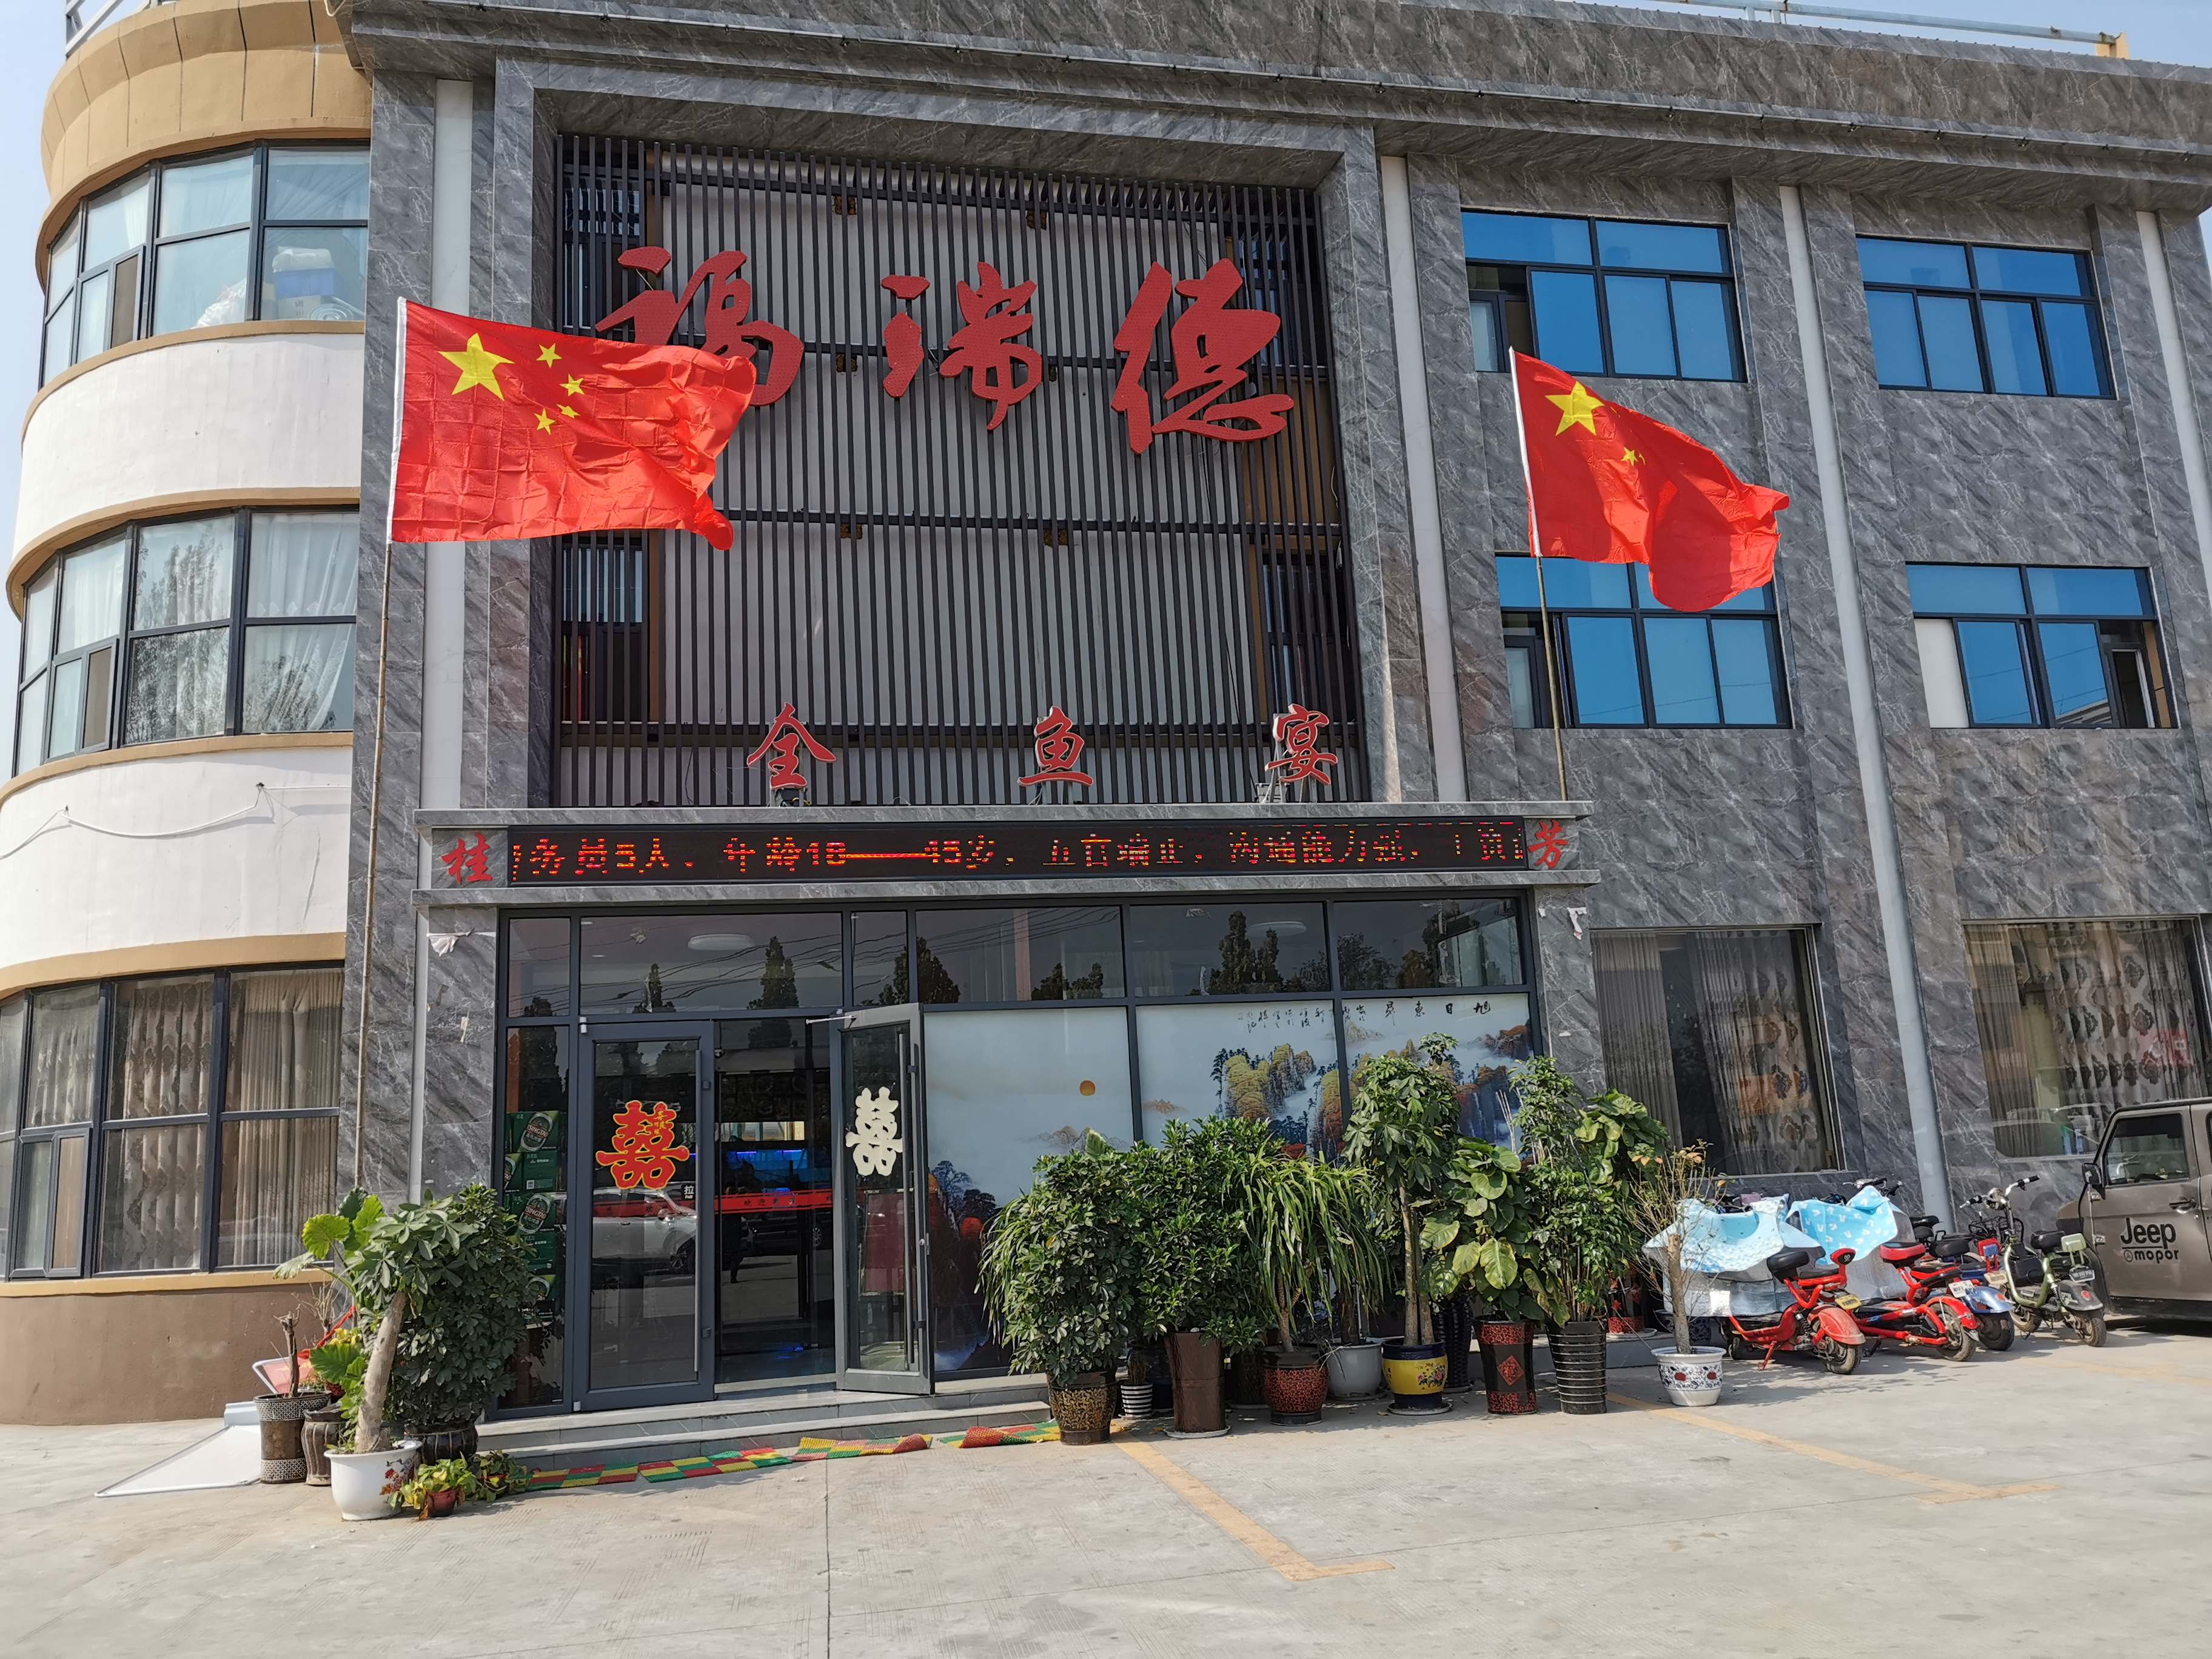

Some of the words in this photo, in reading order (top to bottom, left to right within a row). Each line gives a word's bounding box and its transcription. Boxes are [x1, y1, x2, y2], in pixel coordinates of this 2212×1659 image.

[746, 702, 1338, 789] 全鱼宴
[441, 832, 493, 883] 桂
[1527, 819, 1569, 870] 芳
[683, 1185, 695, 1195] 拉
[2120, 1217, 2176, 1250] Jeep
